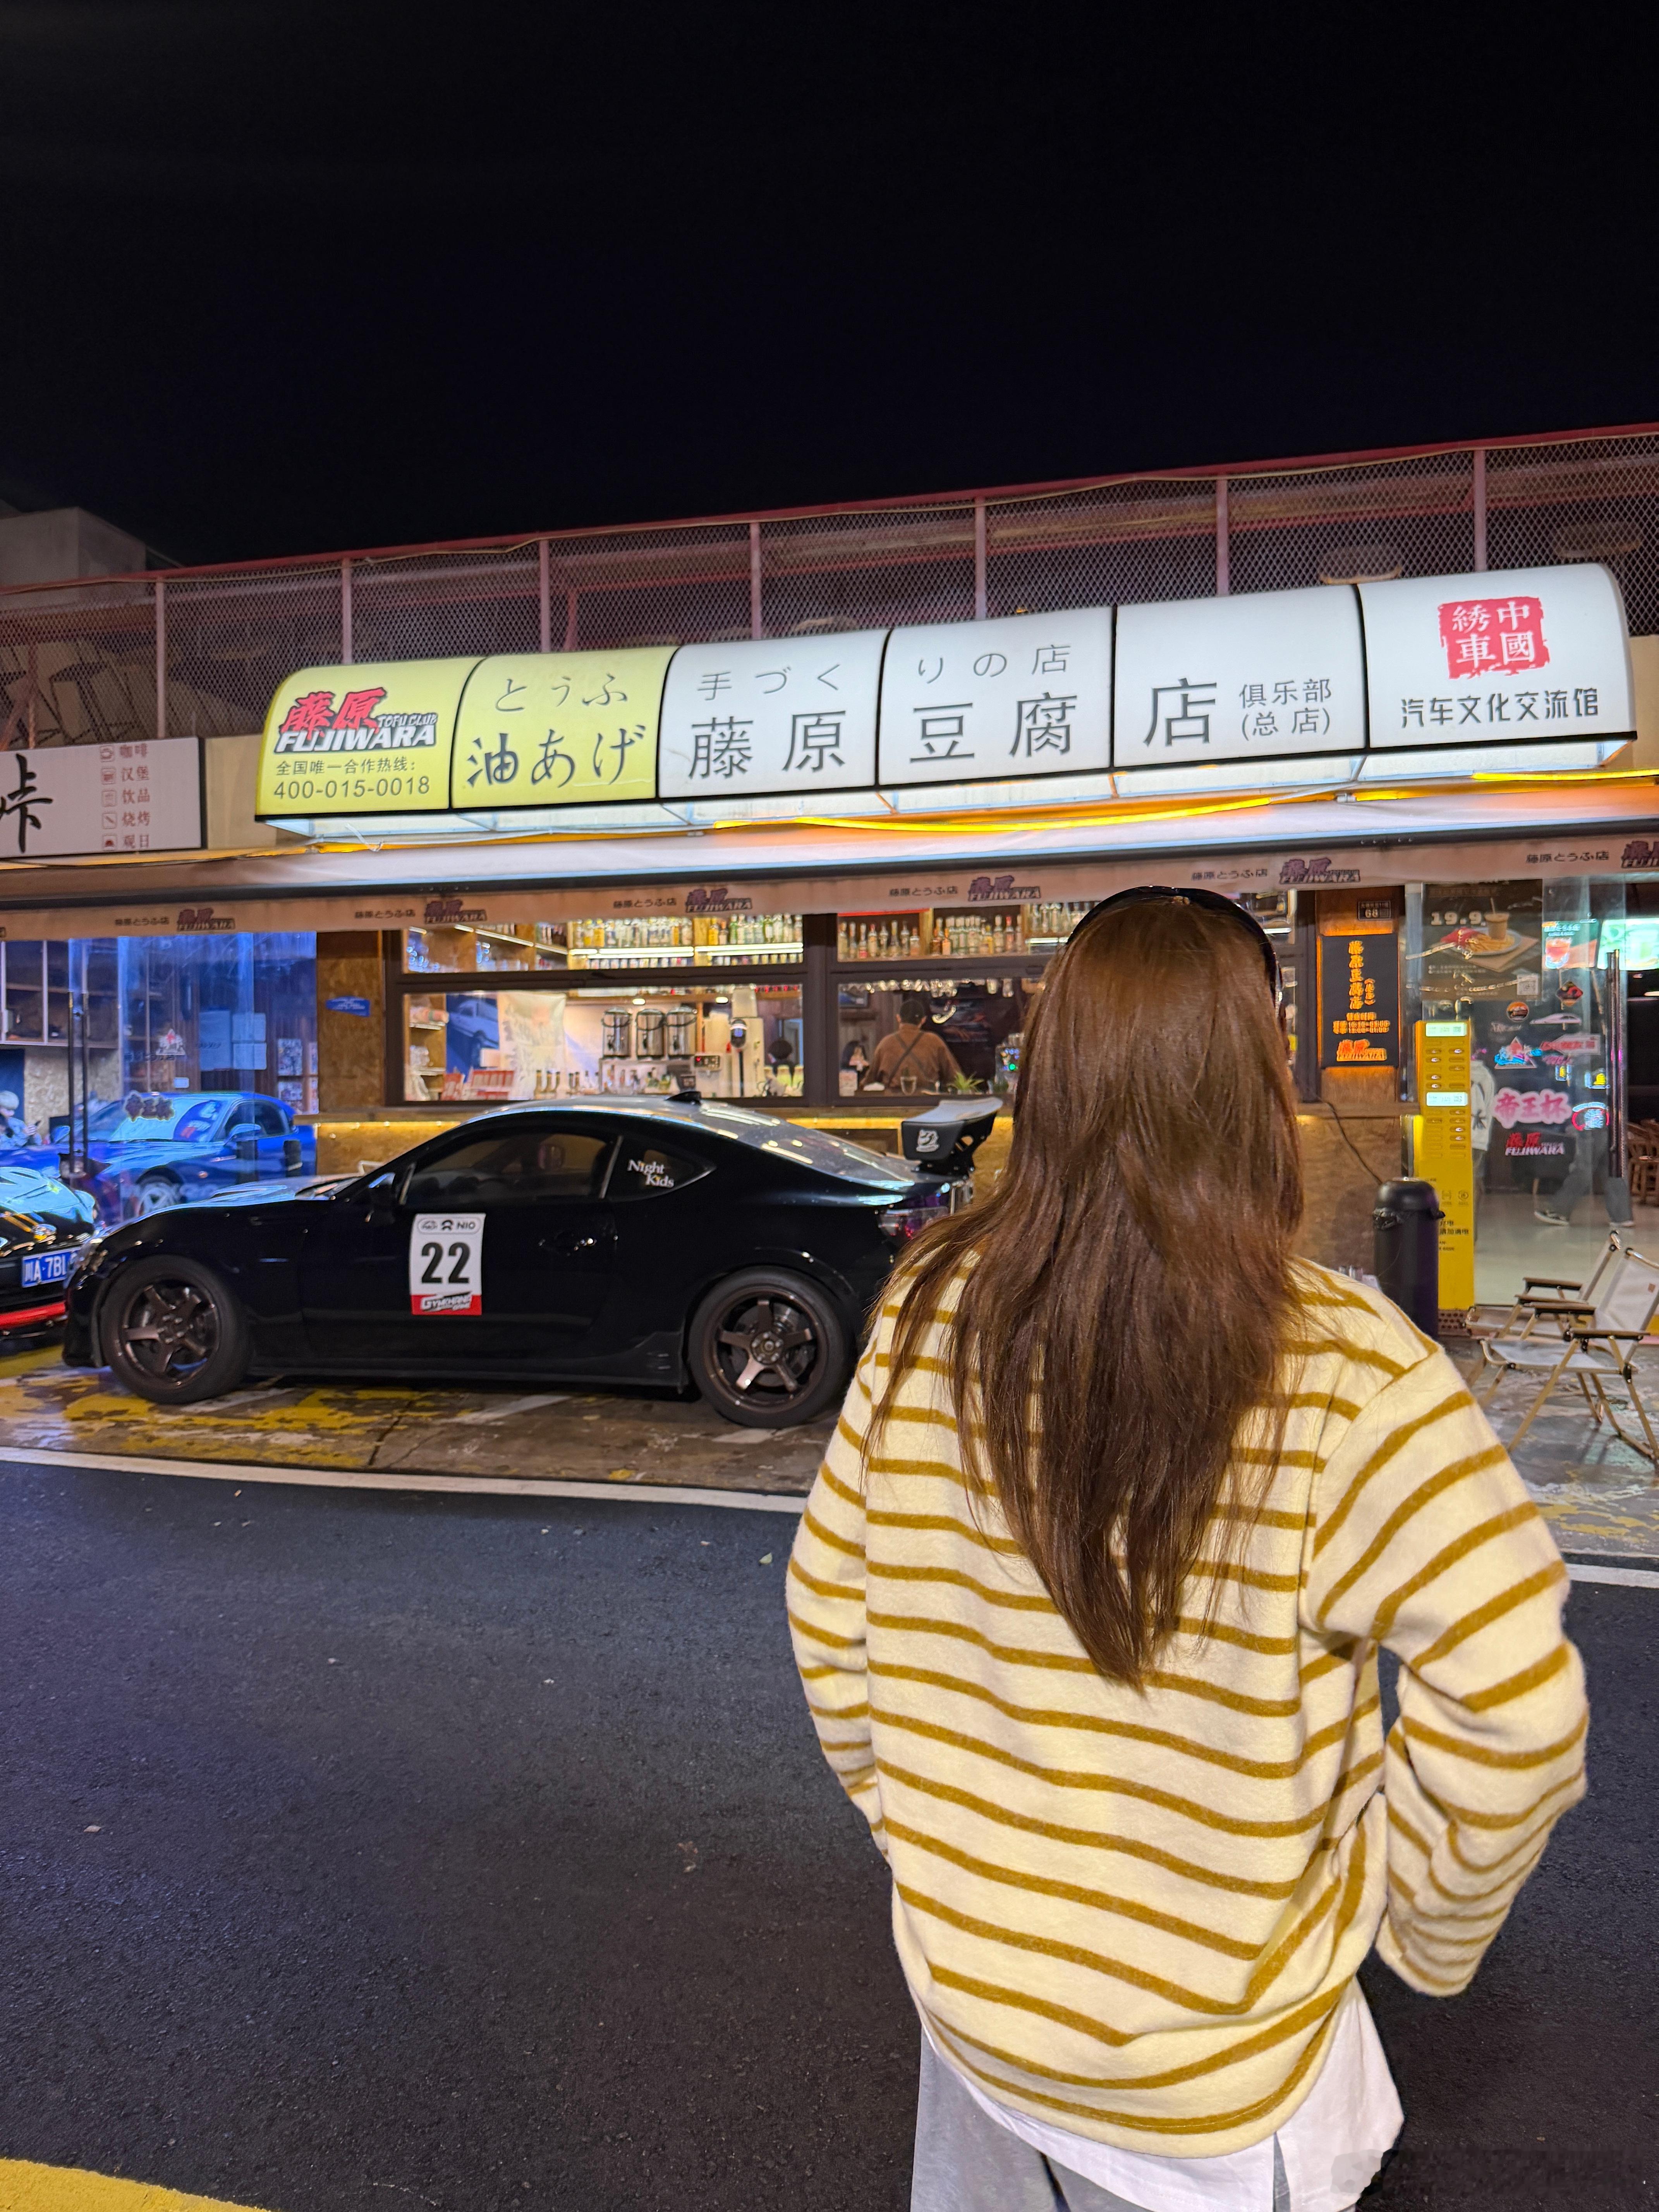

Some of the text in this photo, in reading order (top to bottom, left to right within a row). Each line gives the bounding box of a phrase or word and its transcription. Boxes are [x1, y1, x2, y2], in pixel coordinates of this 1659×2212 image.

[495, 673, 628, 713] とうふ
[1239, 678, 1332, 708] 俱乐部
[281, 687, 386, 740] 藤原
[1400, 687, 1599, 729] 汽车文化交流馆
[376, 714, 437, 728] TOFU CLUB
[276, 725, 434, 752] FUJIWARA
[119, 743, 148, 759] 咖啡
[466, 724, 647, 788] 油あげ
[121, 766, 150, 782] 汉堡
[122, 788, 151, 805] 饮品
[274, 776, 430, 799] 400-015-0018
[121, 811, 151, 828] 烧烤
[1494, 1091, 1567, 1120] 帝王杯
[1505, 1145, 1565, 1156] FUJIWARA
[627, 1159, 665, 1175] Night
[645, 1174, 675, 1188] Kids
[457, 1221, 476, 1230] NIO
[421, 1242, 471, 1285] 22
